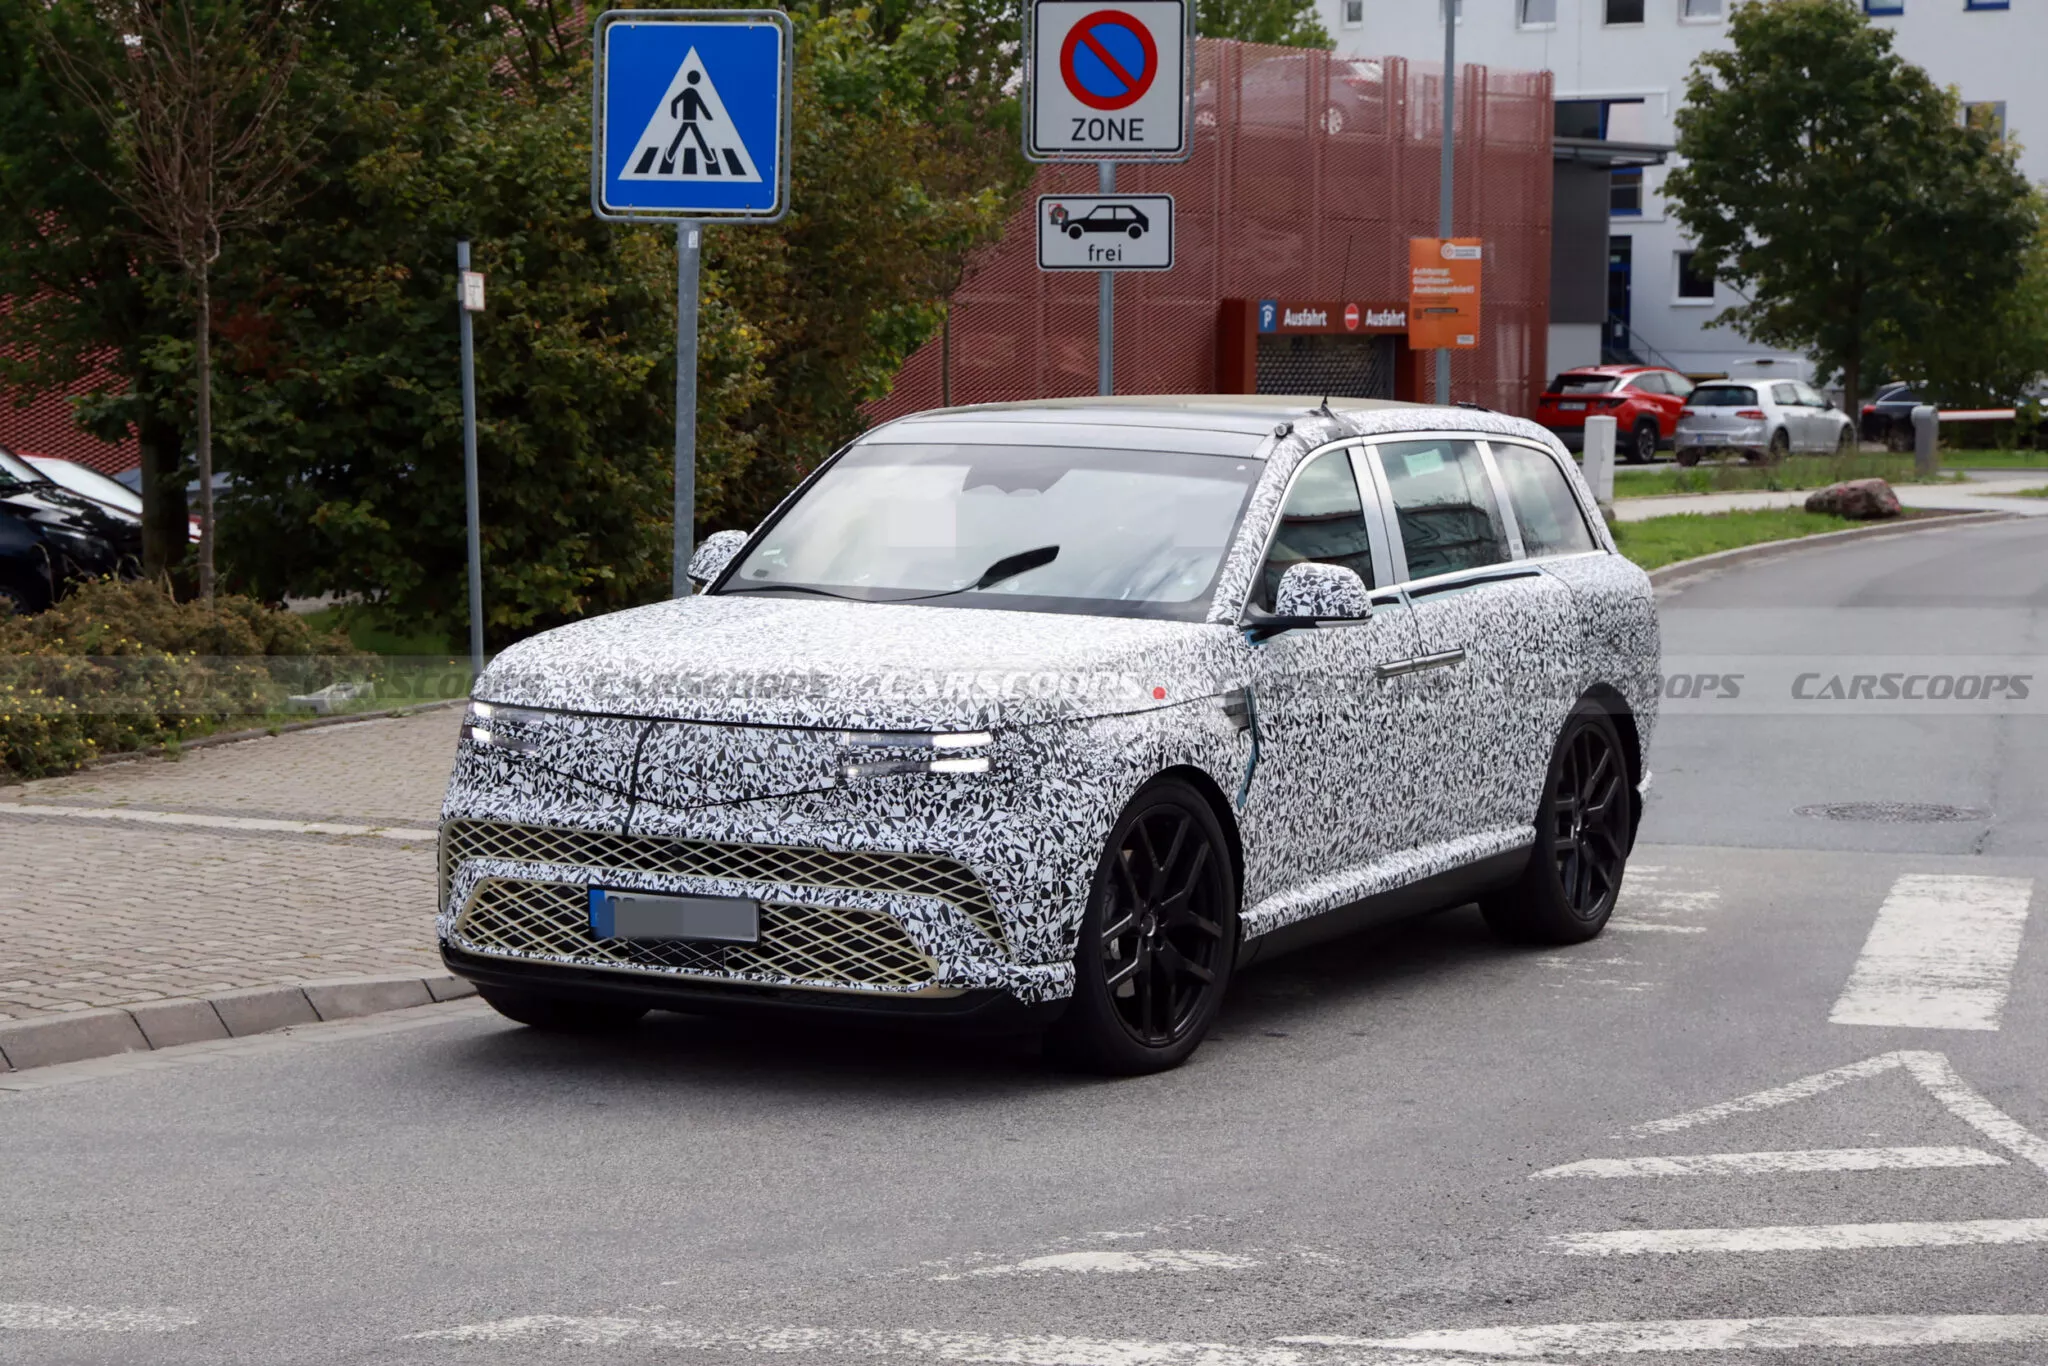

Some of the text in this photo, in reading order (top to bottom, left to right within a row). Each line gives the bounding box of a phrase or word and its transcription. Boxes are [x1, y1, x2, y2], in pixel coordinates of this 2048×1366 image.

[1071, 118, 1144, 141] ZONE
[1088, 244, 1122, 262] frei
[1284, 308, 1327, 327] Ausfahrt
[1365, 309, 1406, 327] Ausfahrt
